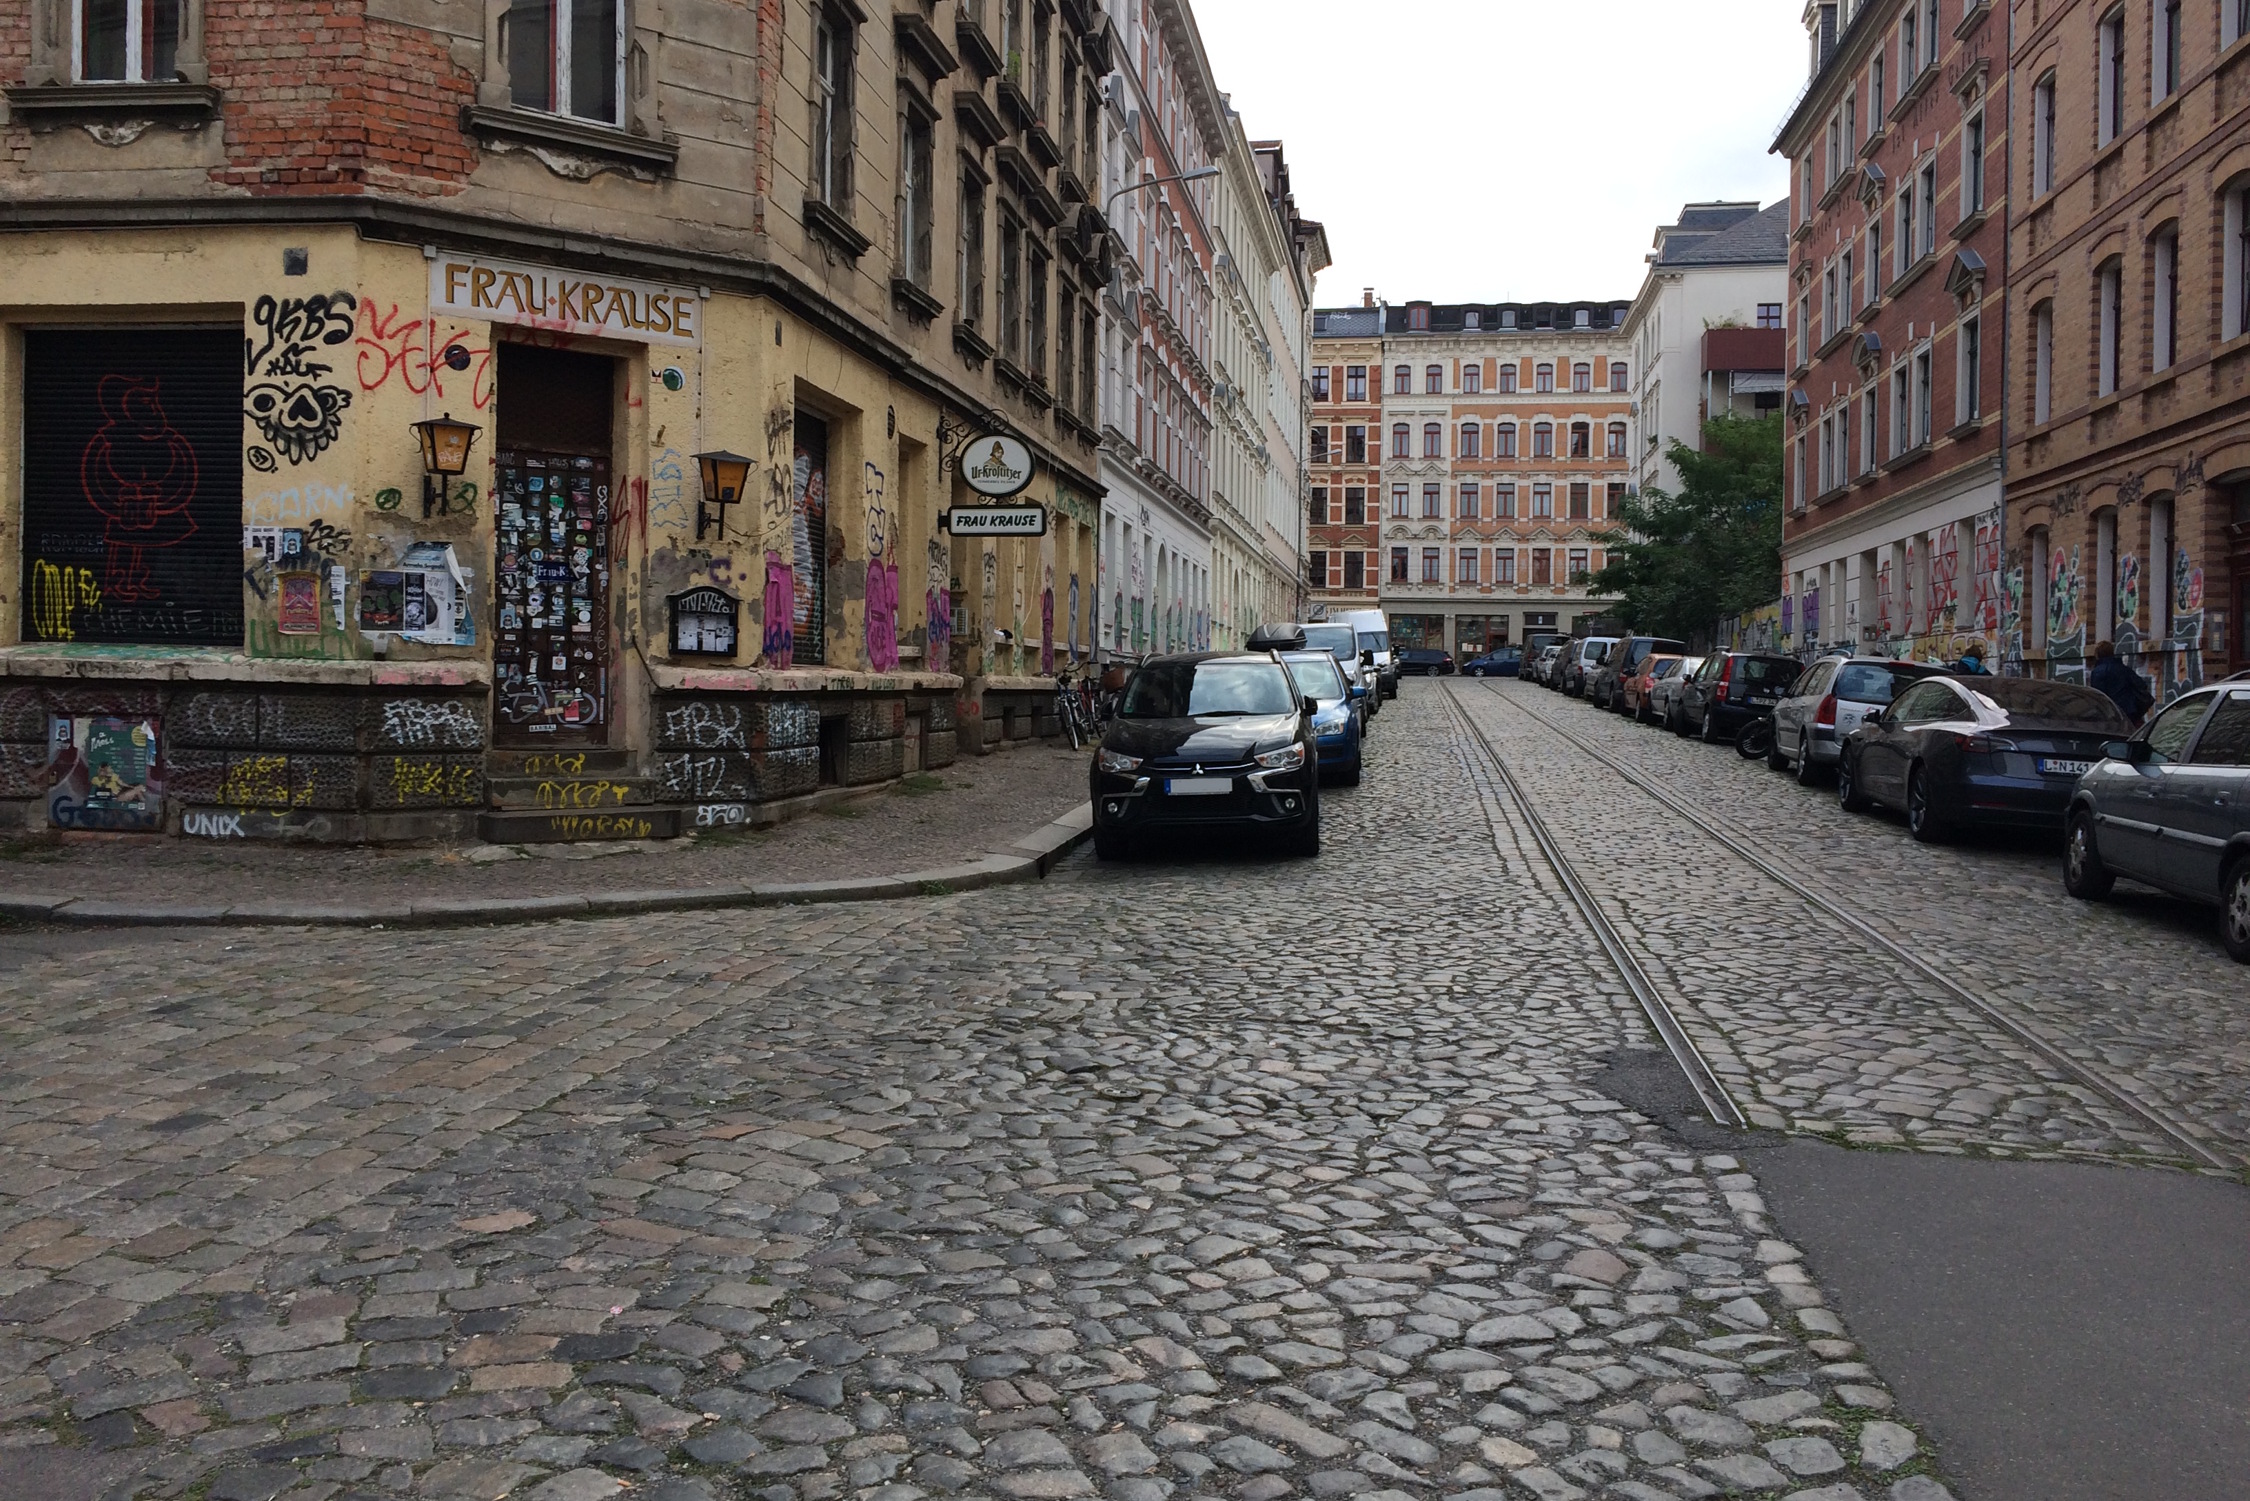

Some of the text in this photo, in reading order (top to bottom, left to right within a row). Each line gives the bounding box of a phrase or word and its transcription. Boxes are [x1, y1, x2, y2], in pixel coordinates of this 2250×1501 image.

[956, 514, 1037, 527] FRAU KRAUSE
[183, 813, 246, 838] UNIX
